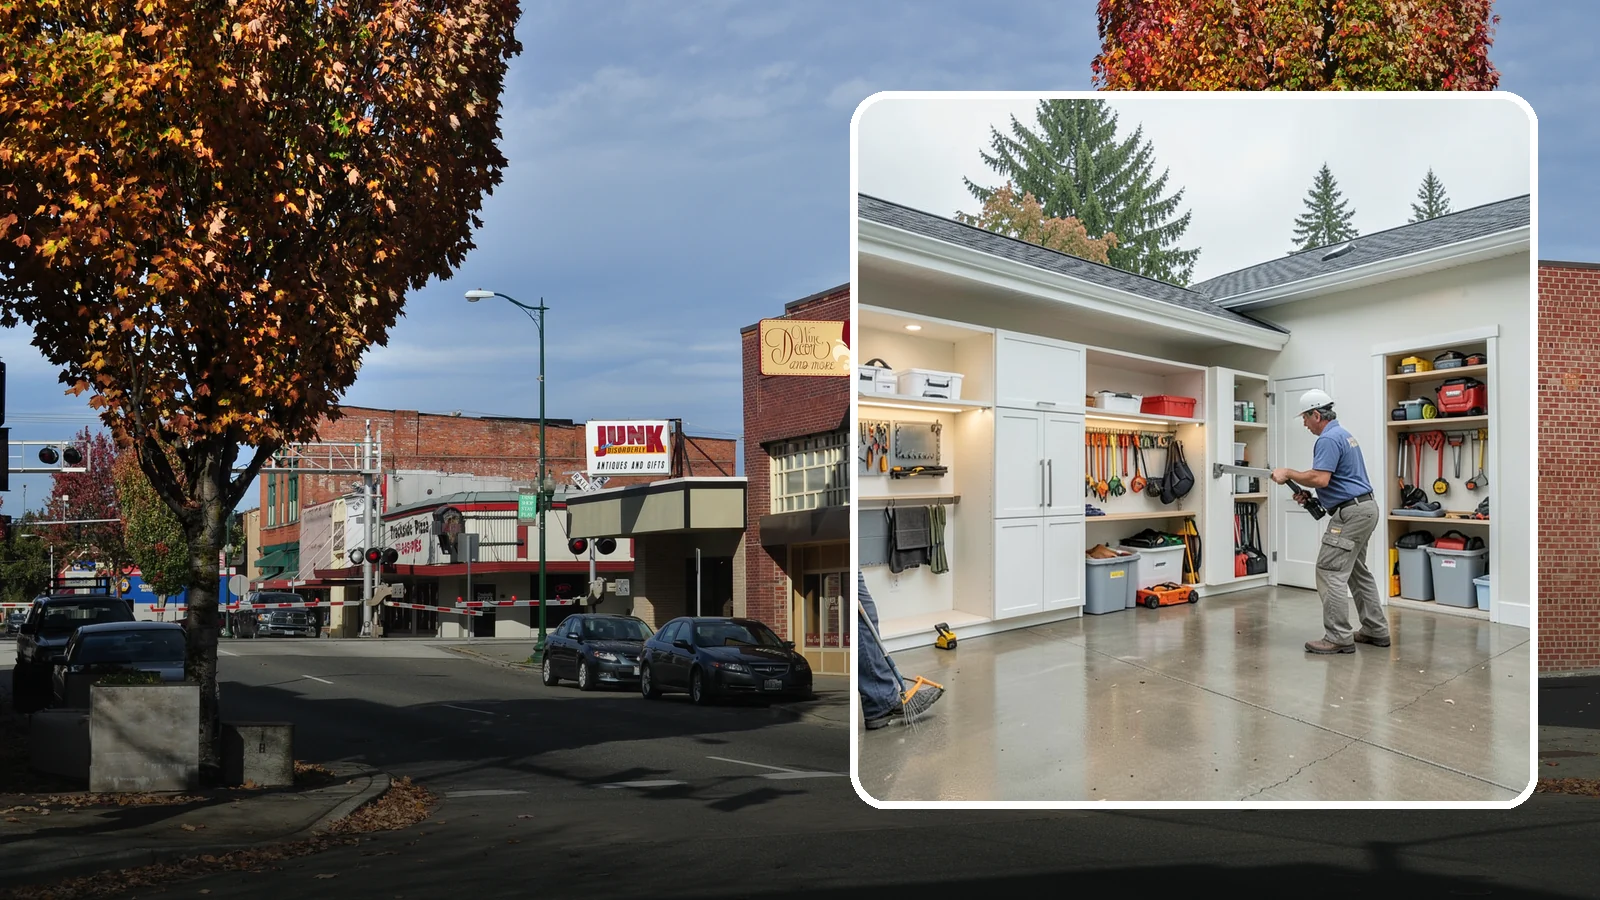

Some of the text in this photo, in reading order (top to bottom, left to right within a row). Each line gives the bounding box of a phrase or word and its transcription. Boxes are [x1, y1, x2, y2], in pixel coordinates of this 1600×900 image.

[595, 425, 665, 457] JUNK
[607, 445, 646, 454] DISORDERLY
[596, 460, 666, 470] ANTIQUES AND GIFTS
[573, 473, 588, 490] RAIL
[415, 519, 429, 535] Pizza
